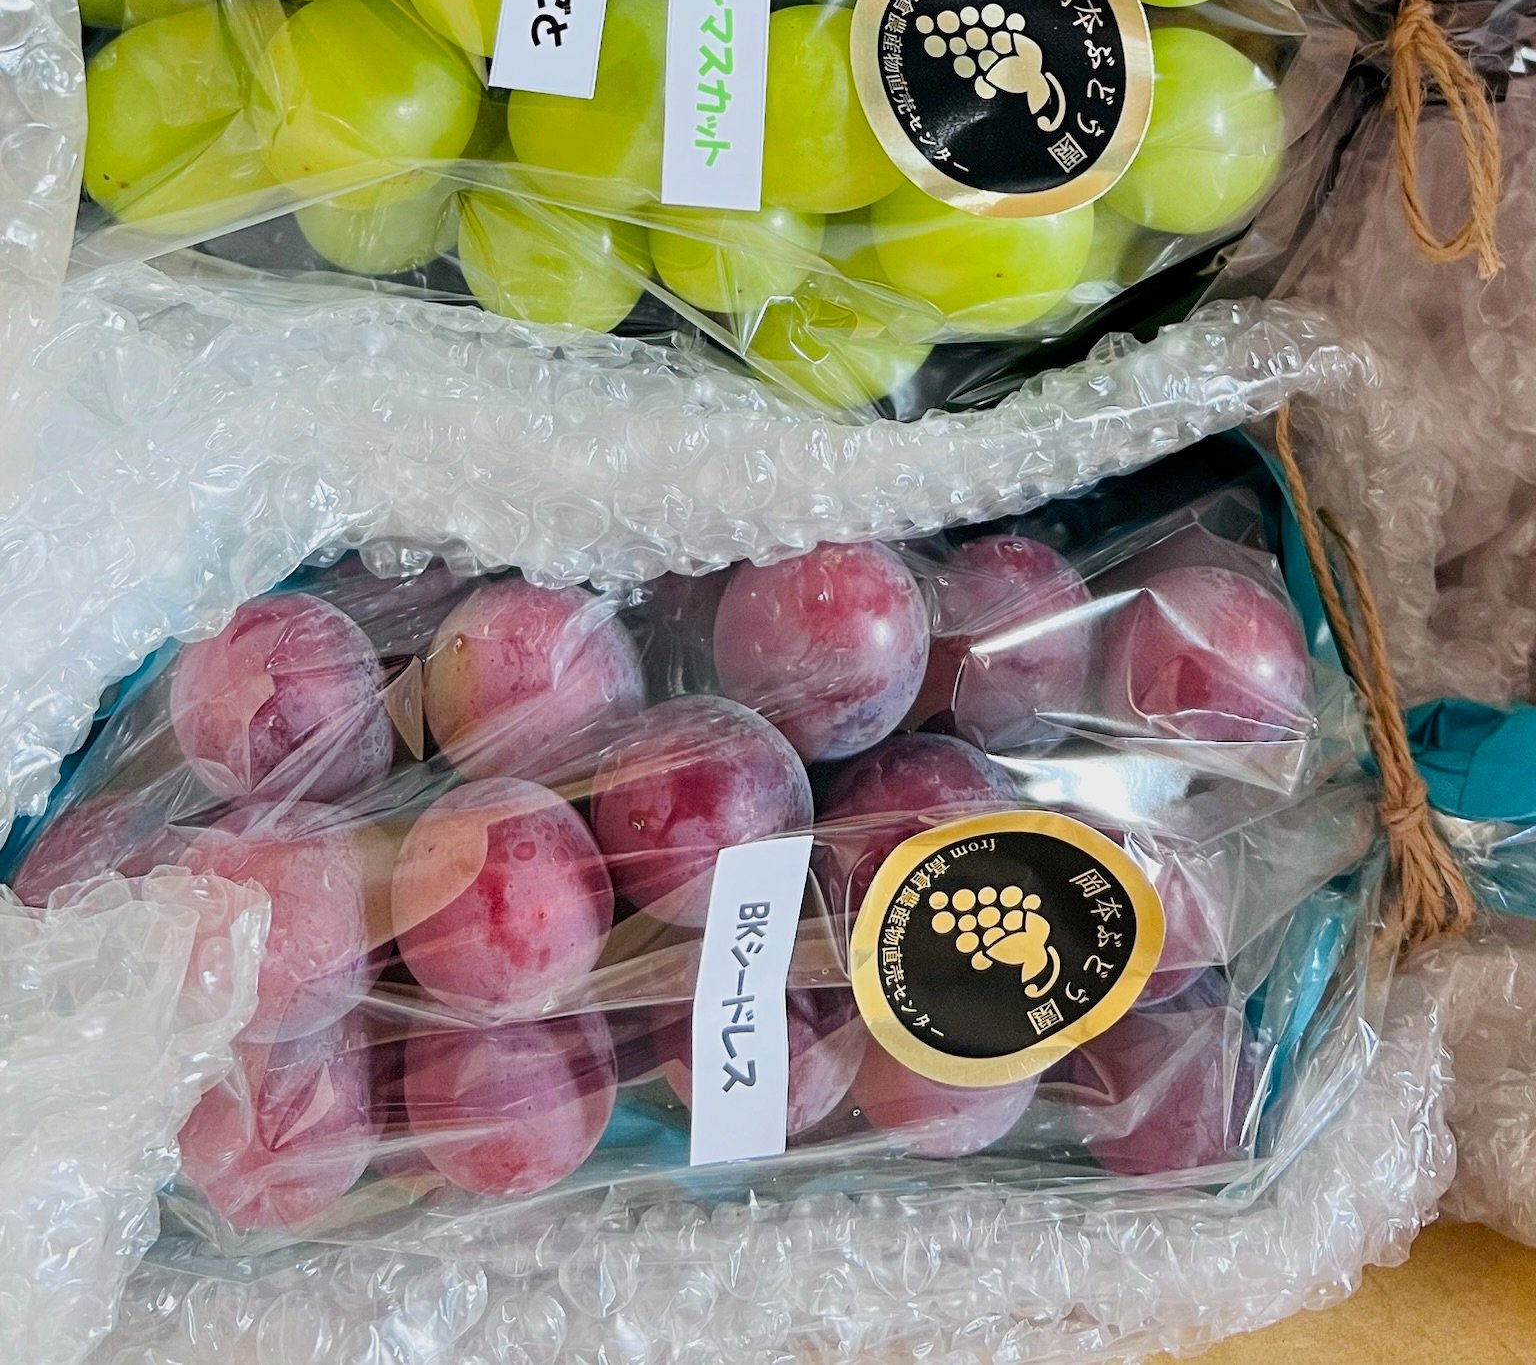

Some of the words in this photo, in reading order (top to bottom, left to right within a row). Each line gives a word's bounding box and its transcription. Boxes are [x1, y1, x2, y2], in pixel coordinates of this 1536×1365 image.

[950, 837, 997, 859] from
[720, 900, 772, 1093] BKシードレス
[882, 854, 950, 1038] 高倉農産物直売センター
[1026, 867, 1124, 1036] 岡本ぶどう園
